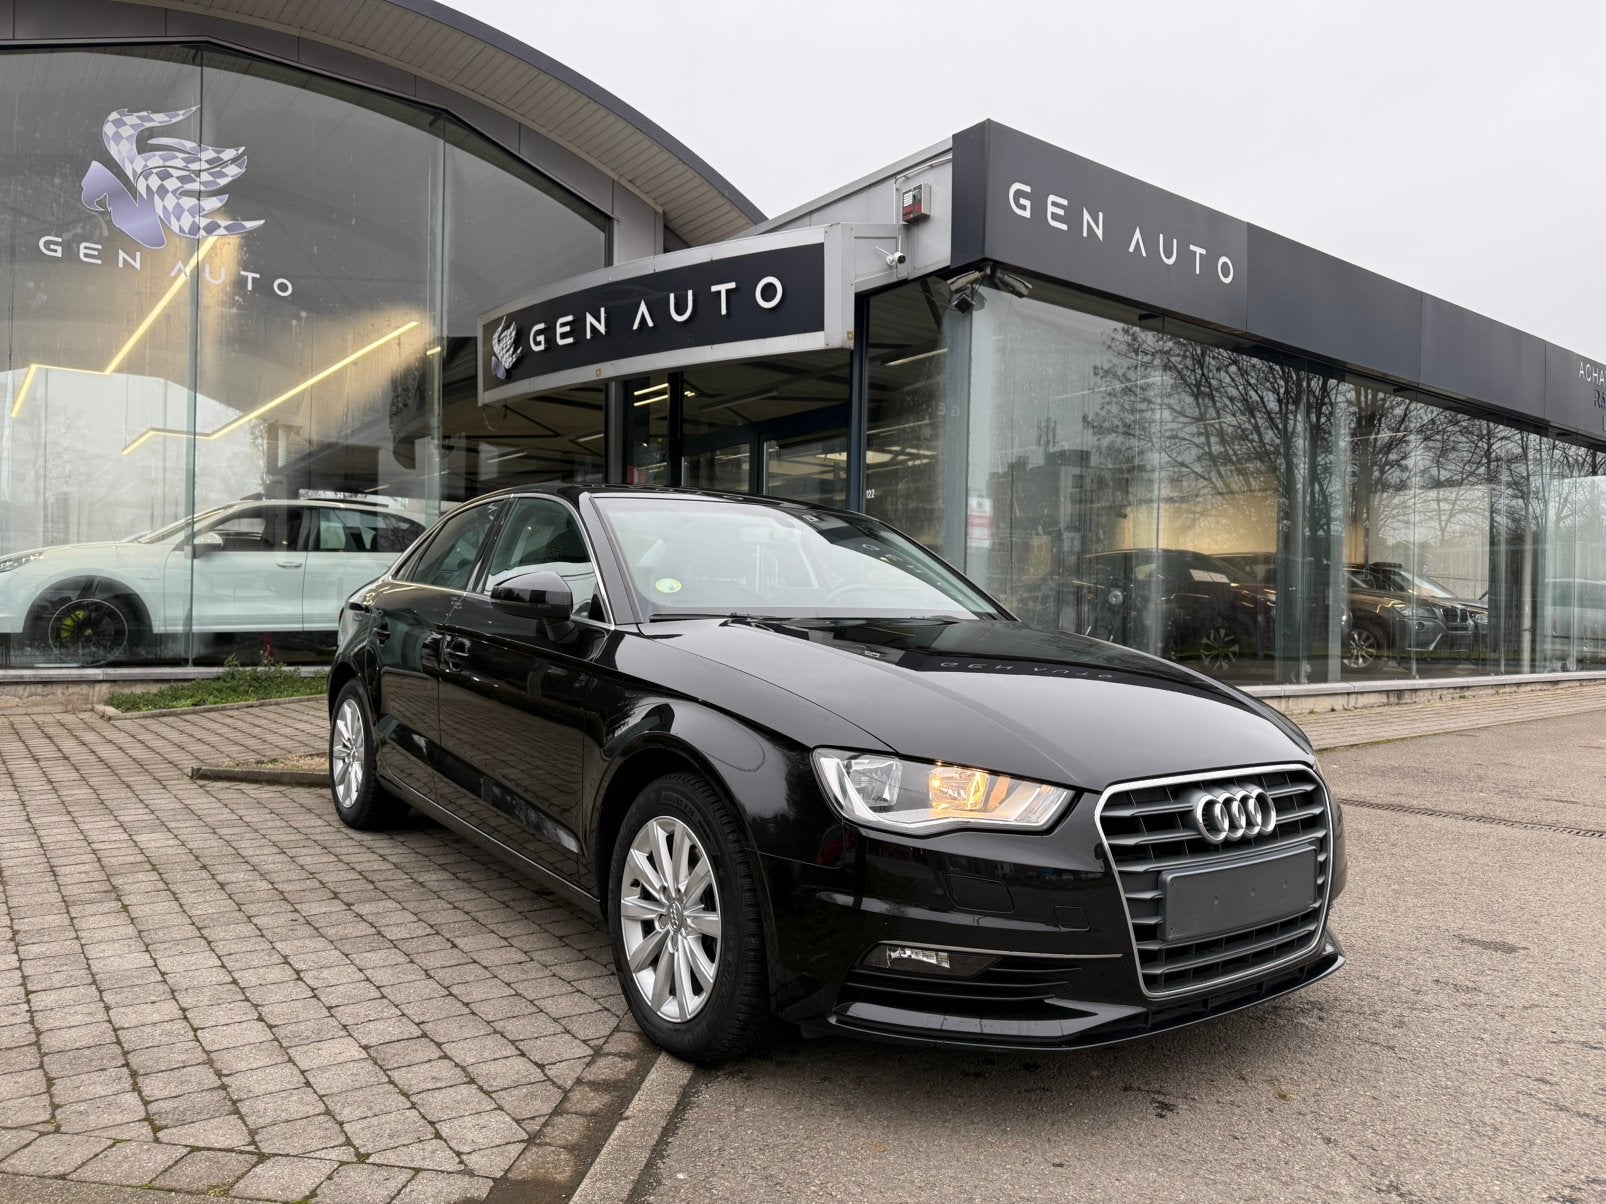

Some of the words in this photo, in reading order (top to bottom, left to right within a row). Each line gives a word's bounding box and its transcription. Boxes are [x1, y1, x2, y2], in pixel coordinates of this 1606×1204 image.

[1008, 182, 1104, 242] GEN
[1128, 226, 1234, 284] AUTO
[38, 235, 142, 271] GEN
[170, 260, 293, 297] AUTO
[529, 307, 608, 352] GEN
[632, 276, 783, 331] AUTO
[1578, 361, 1606, 387] ACHA
[866, 489, 875, 499] 122
